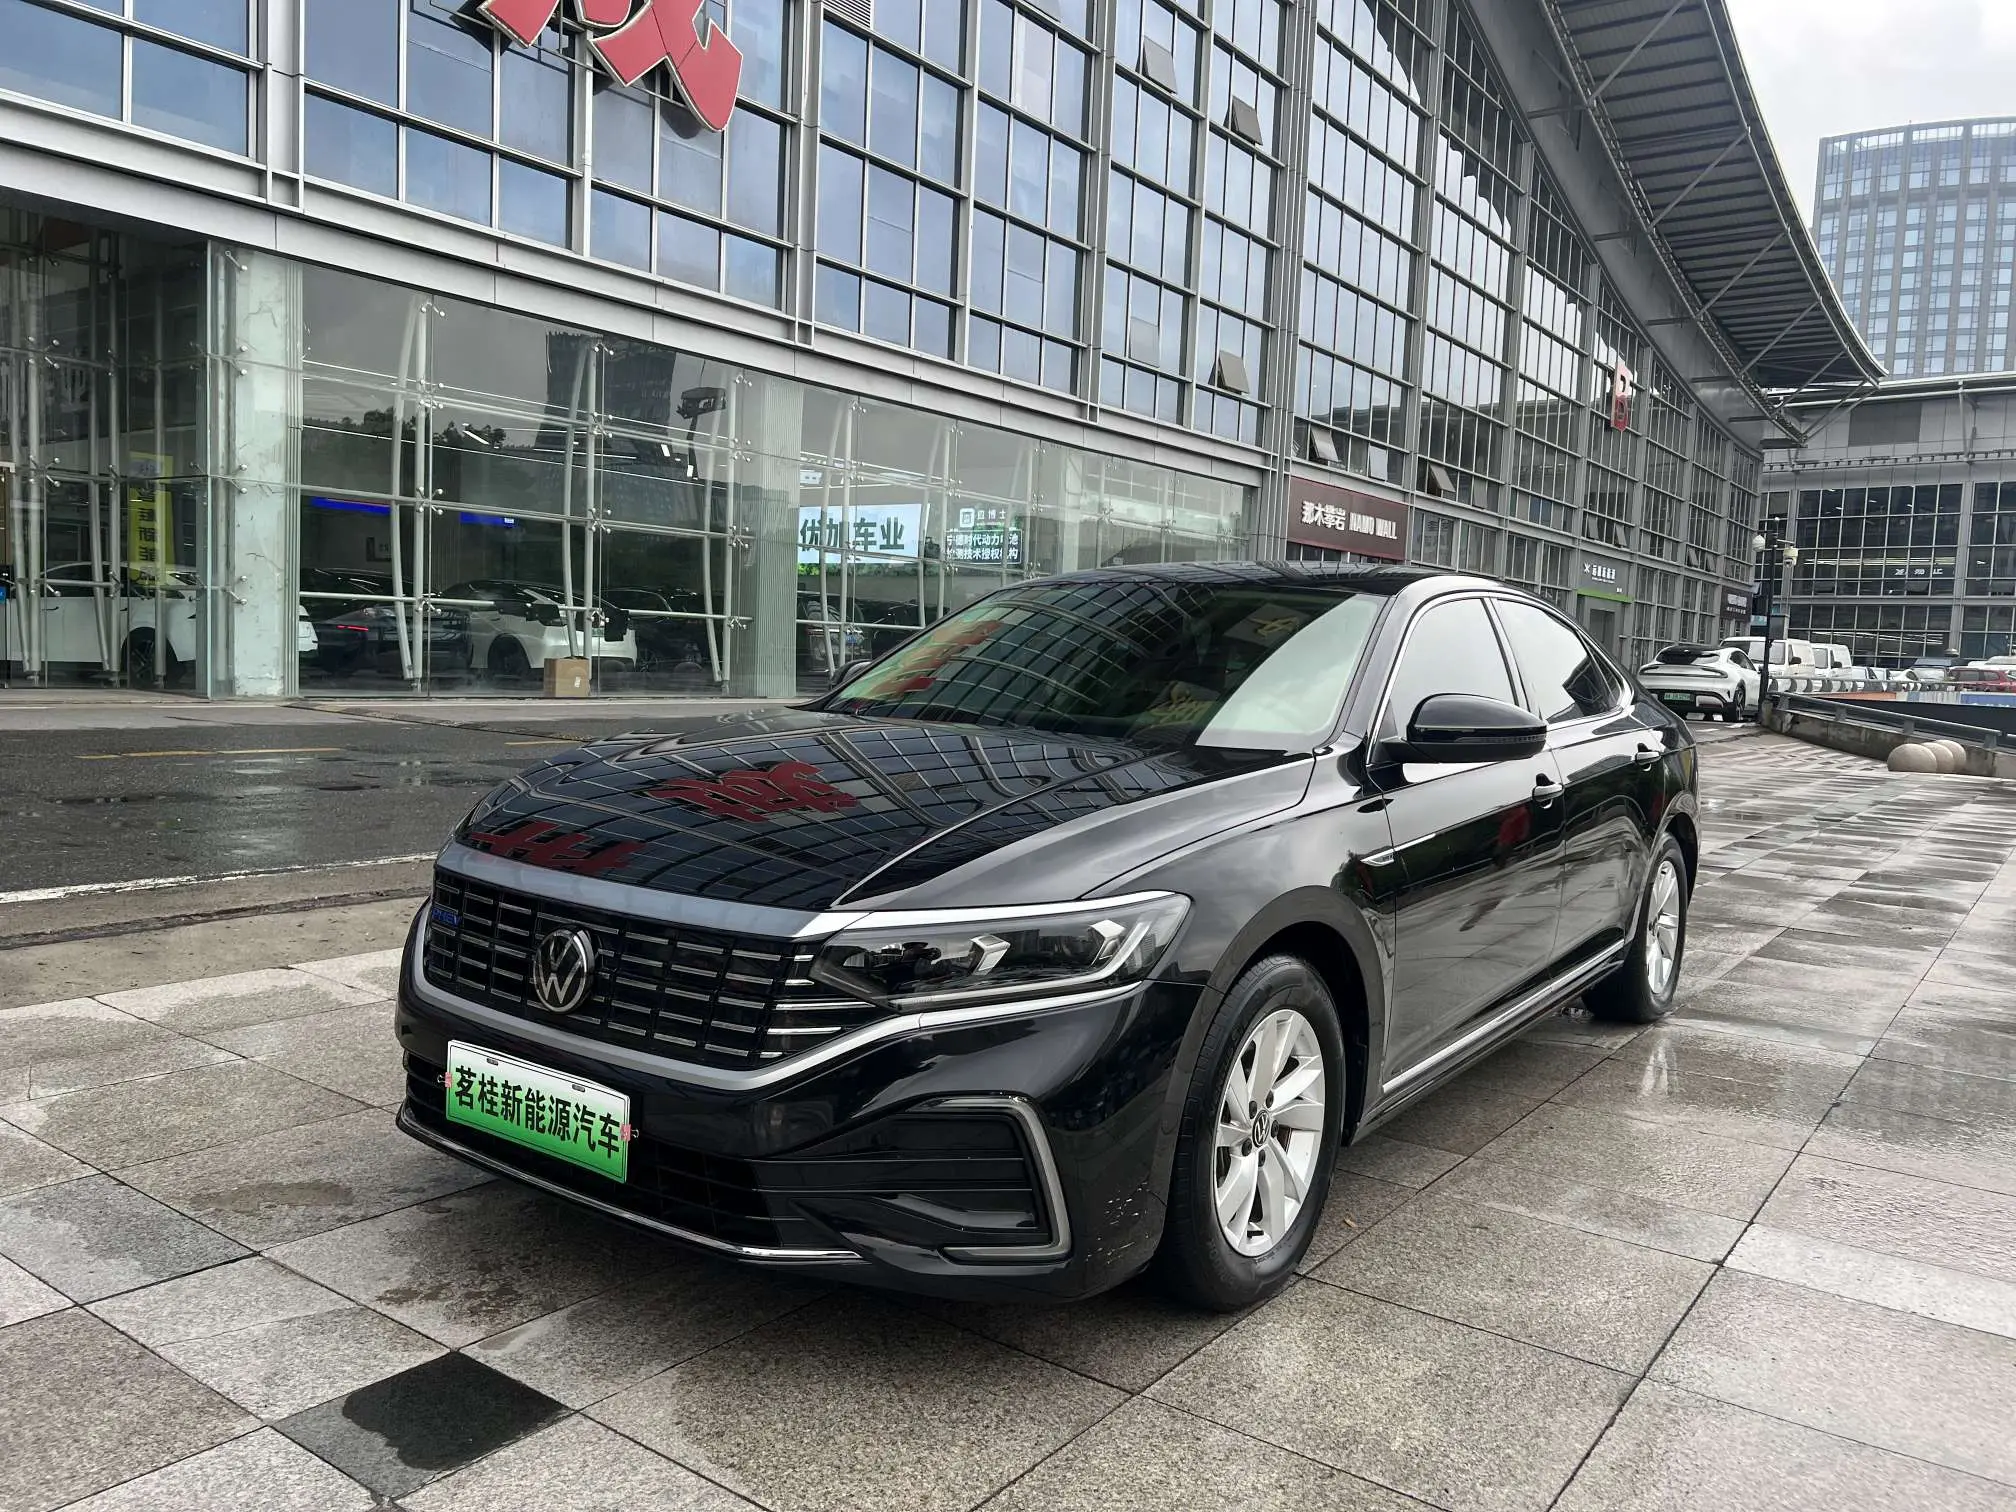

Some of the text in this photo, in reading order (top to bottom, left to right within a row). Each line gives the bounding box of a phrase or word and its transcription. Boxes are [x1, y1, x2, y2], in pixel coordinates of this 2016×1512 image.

[432, 908, 462, 926] PHEV
[454, 1066, 620, 1159] 茗桂新能源汽车
